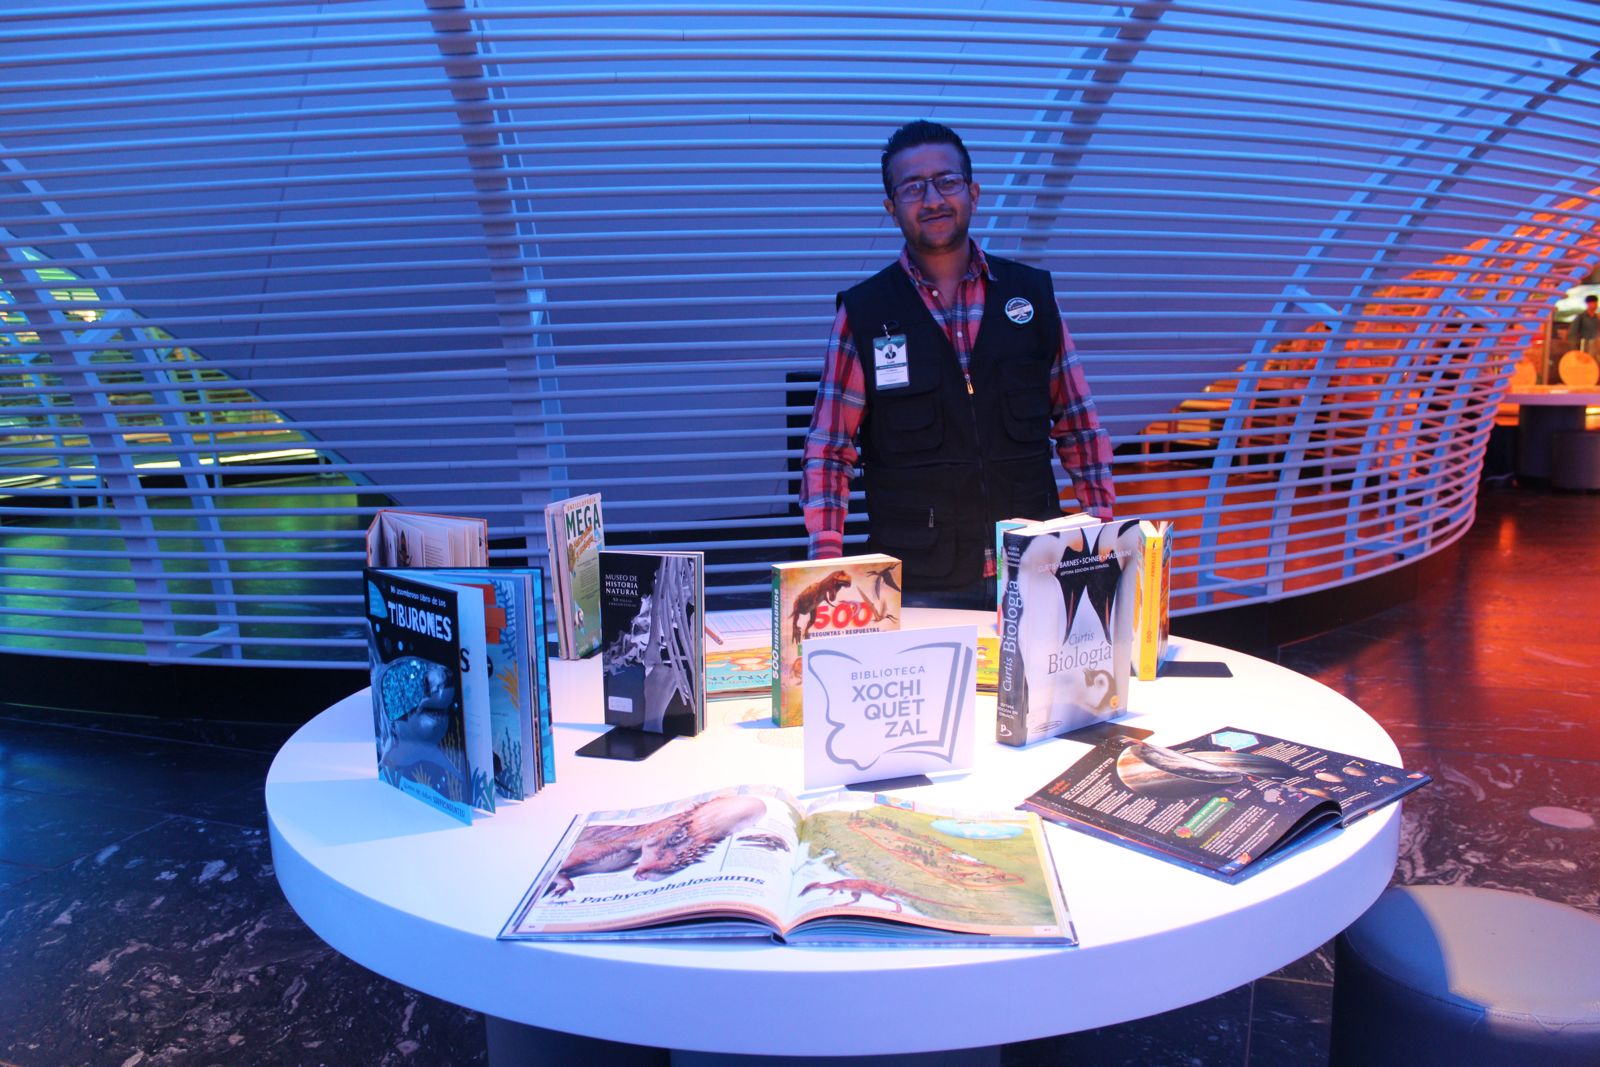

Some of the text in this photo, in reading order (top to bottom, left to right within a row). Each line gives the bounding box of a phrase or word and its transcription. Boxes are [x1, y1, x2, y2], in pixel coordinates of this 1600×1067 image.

[565, 503, 601, 540] MEGA
[1059, 557, 1079, 569] BARNES
[605, 574, 628, 582] MUSEO
[605, 581, 639, 589] HISTORIA
[431, 596, 438, 605] de
[605, 588, 638, 596] NATURAL
[387, 600, 453, 642] TIBURONES
[813, 600, 873, 629] 500
[1003, 580, 1023, 655] Biología
[845, 627, 880, 636] RESPUESTAS
[1068, 630, 1094, 648] Curtis
[1048, 640, 1112, 676] Biología
[851, 665, 926, 681] BIBLIOTECA
[1002, 657, 1013, 692] Curtis
[851, 678, 921, 703] XOCHI
[863, 697, 926, 721] QUÉT
[884, 718, 928, 739] ZAL
[578, 874, 767, 905] Pachycephalosaurus
